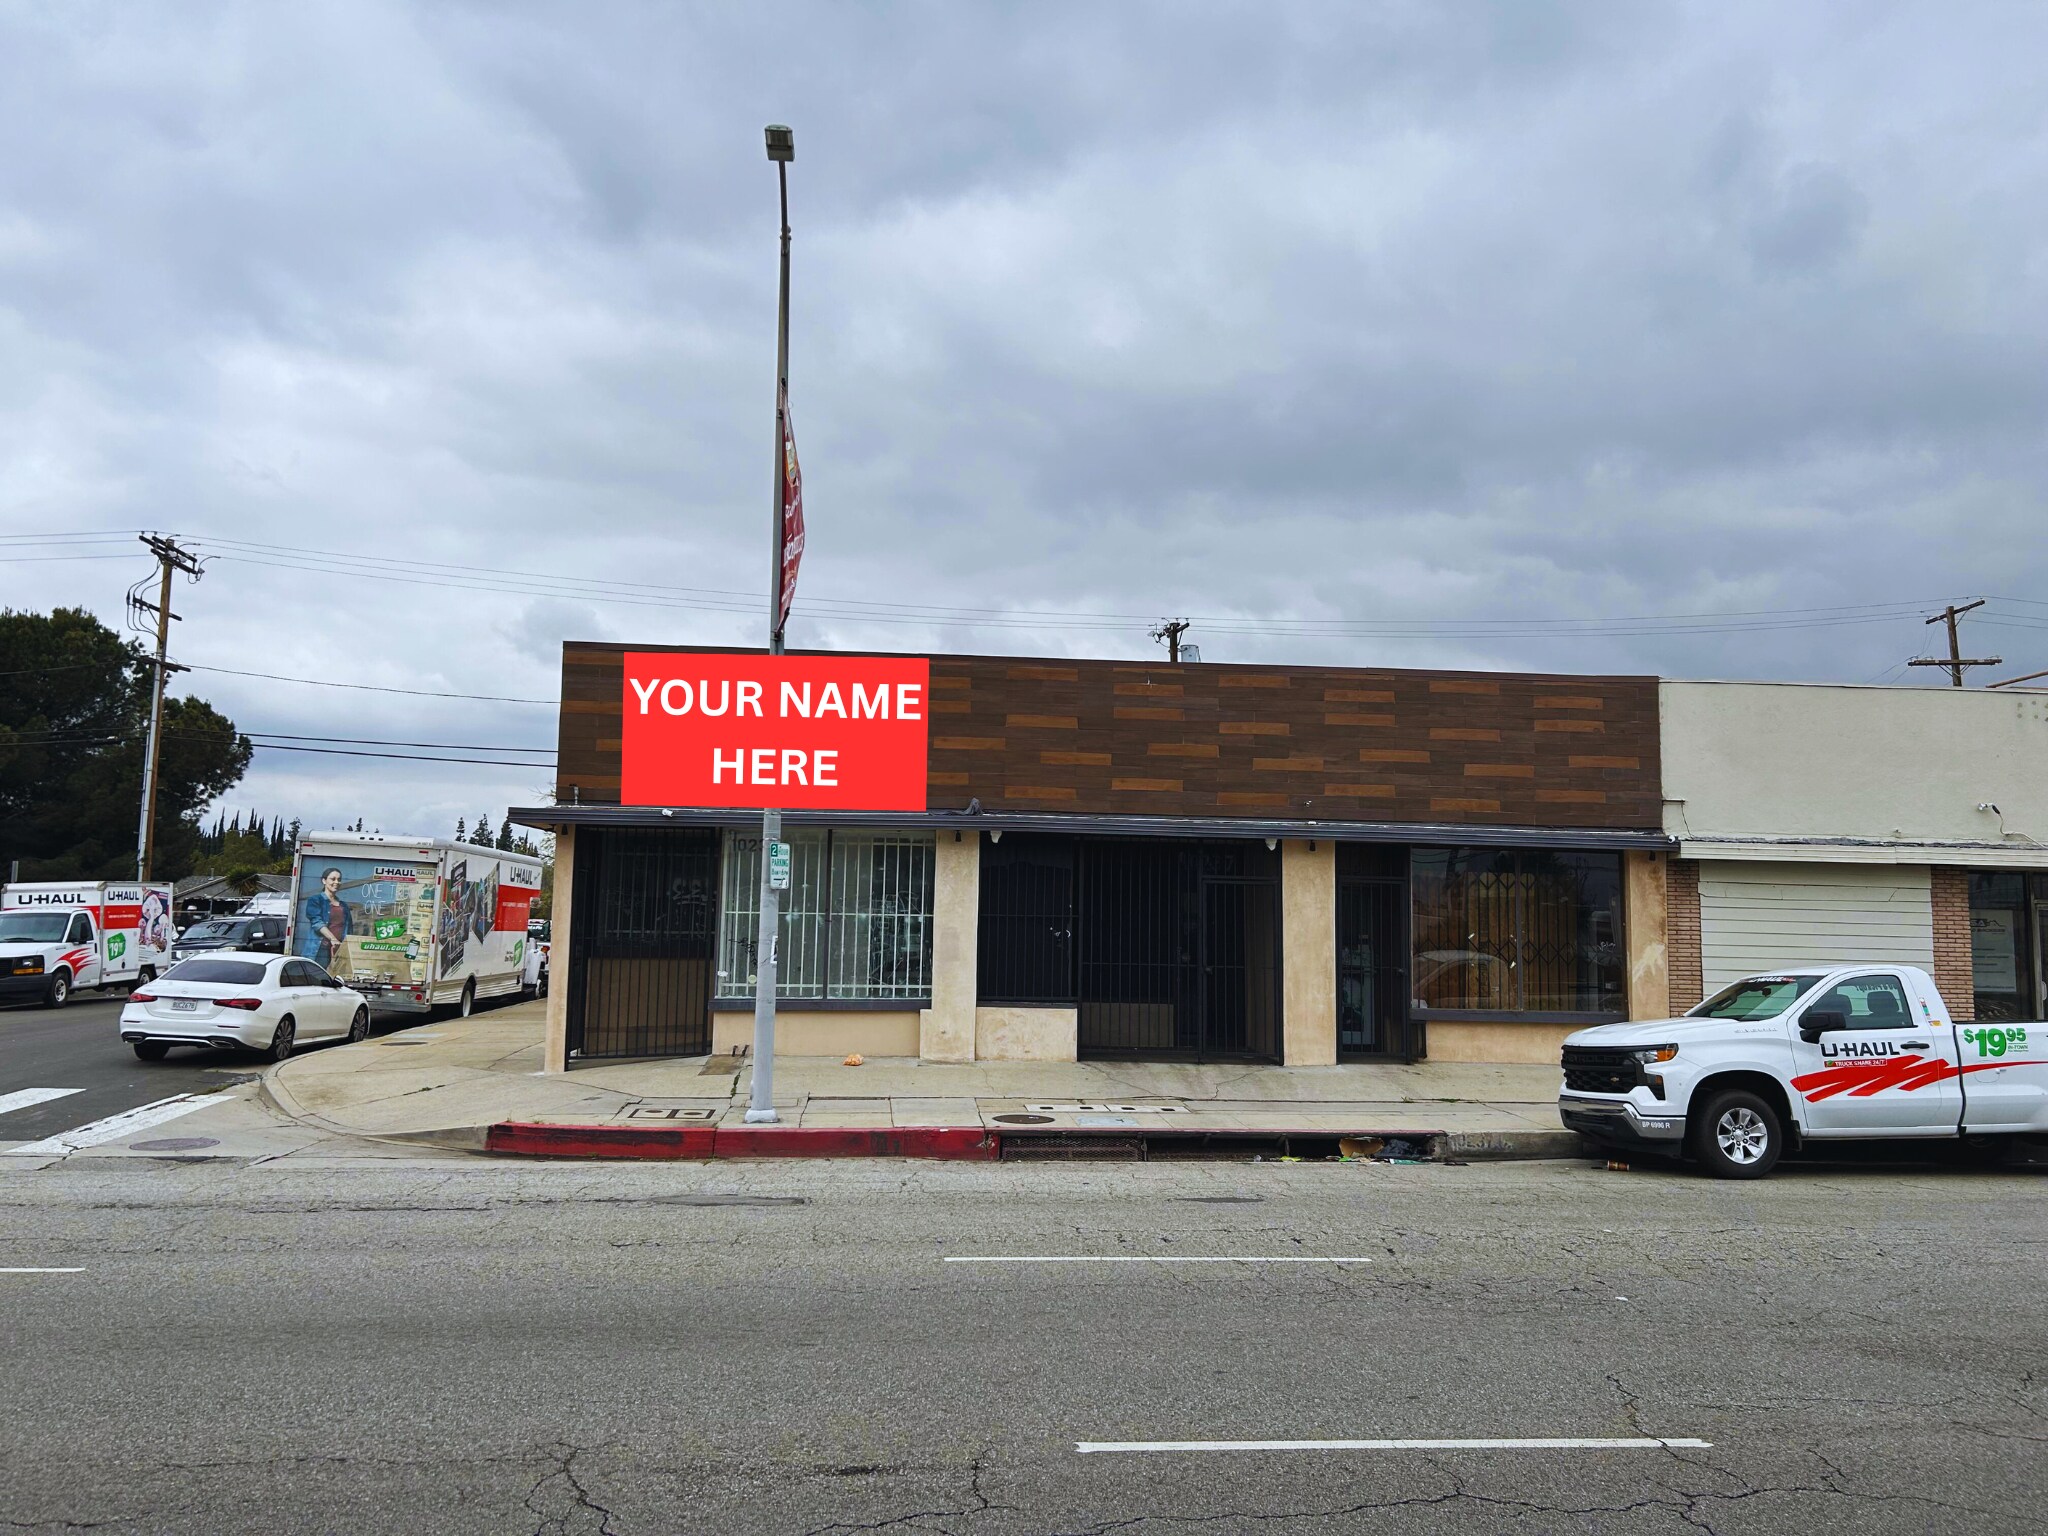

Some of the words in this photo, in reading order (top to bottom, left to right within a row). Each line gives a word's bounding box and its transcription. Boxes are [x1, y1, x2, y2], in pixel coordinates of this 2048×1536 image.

[771, 845, 777, 855] 2
[772, 859, 788, 867] PARKING
[376, 868, 415, 876] U-HAUL
[511, 867, 533, 885] U-HAUL
[18, 894, 86, 905] U-HAUL
[108, 891, 140, 901] U-HAUL
[364, 943, 409, 952] uhaul.com
[1820, 1042, 1901, 1057] U-HAUL
